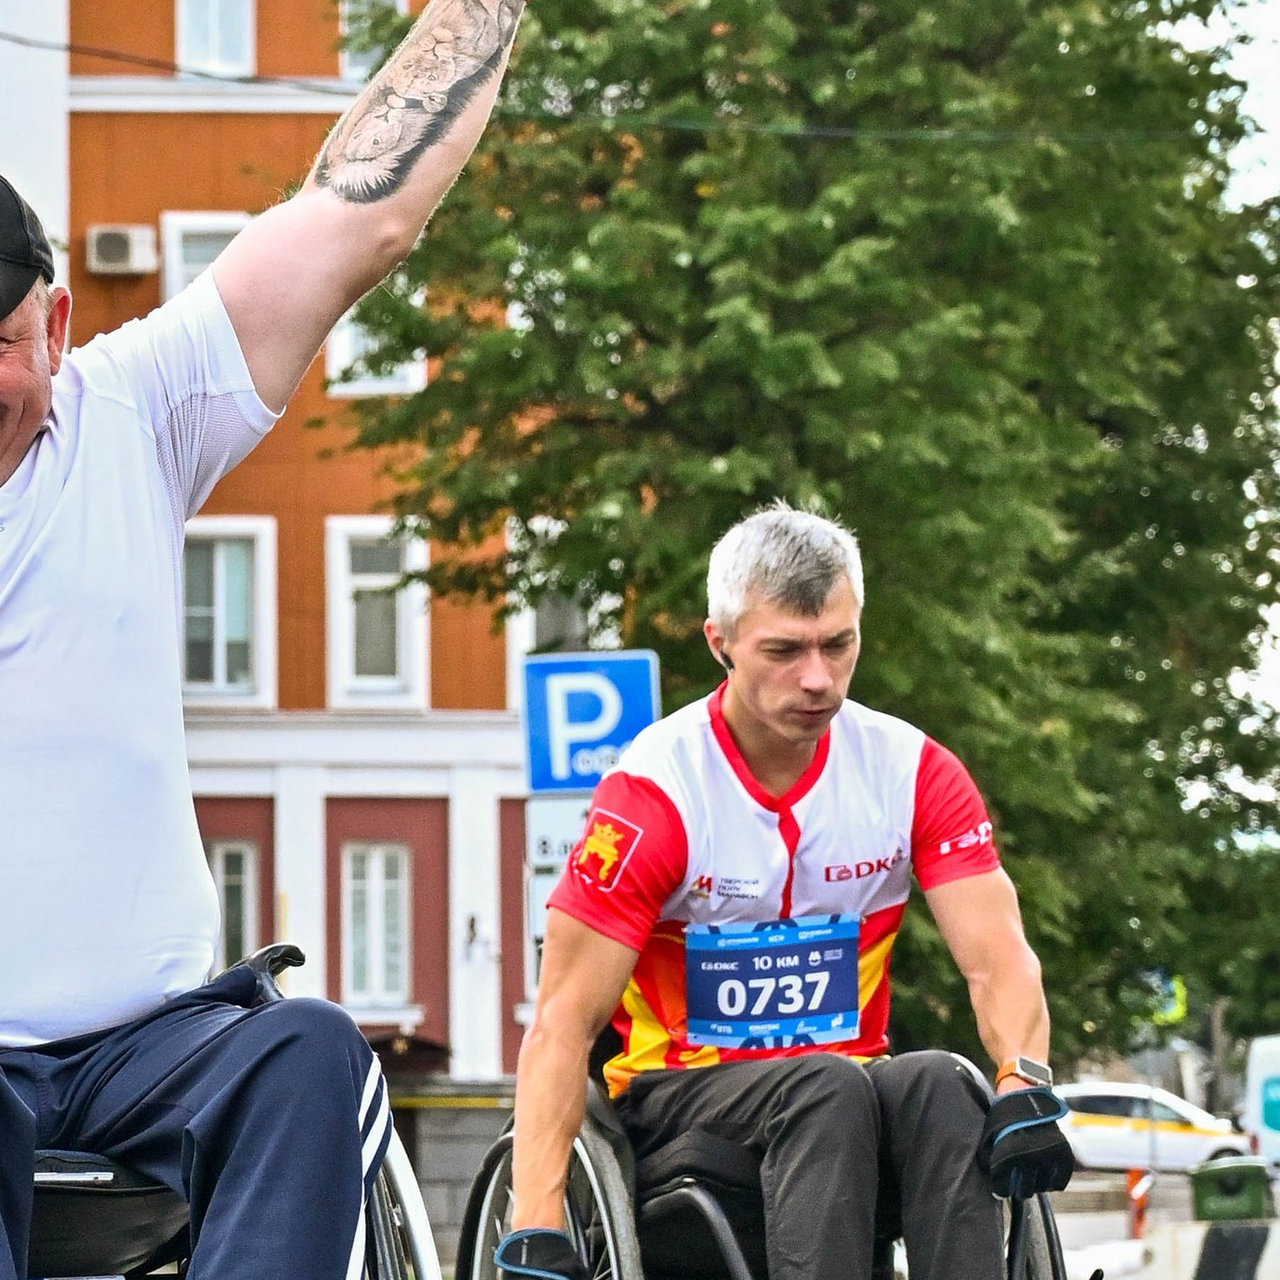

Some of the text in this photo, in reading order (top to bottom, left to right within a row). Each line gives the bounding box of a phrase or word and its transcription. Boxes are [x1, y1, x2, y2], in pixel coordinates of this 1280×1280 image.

[545, 672, 623, 781] P
[752, 955, 773, 971] 10
[717, 971, 831, 1017] 0737
